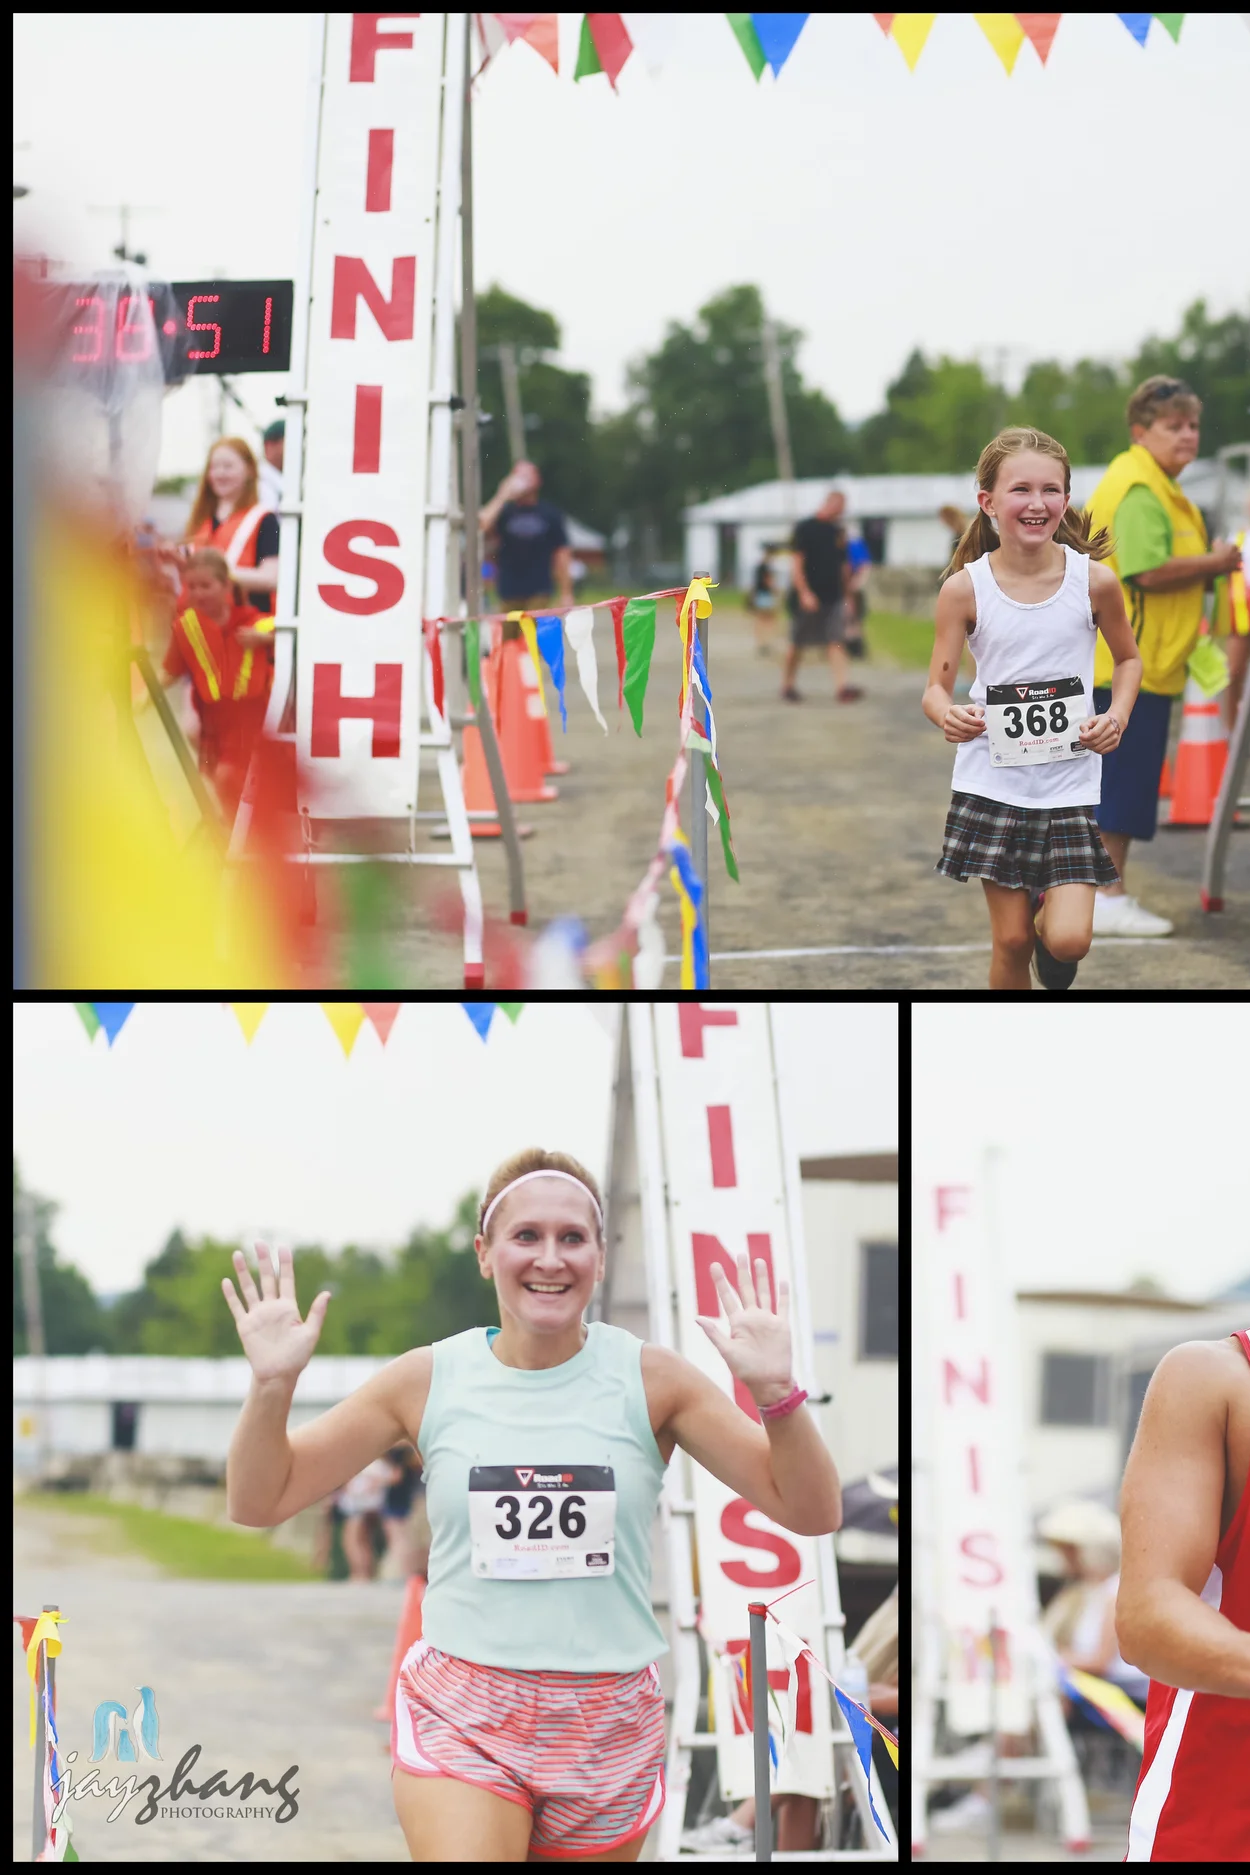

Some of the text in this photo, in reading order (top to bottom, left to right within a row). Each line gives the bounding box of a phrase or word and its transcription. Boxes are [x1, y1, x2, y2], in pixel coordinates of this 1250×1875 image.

[311, 13, 420, 759] FINISH
[1003, 701, 1069, 739] 368
[495, 1495, 587, 1540] 326
